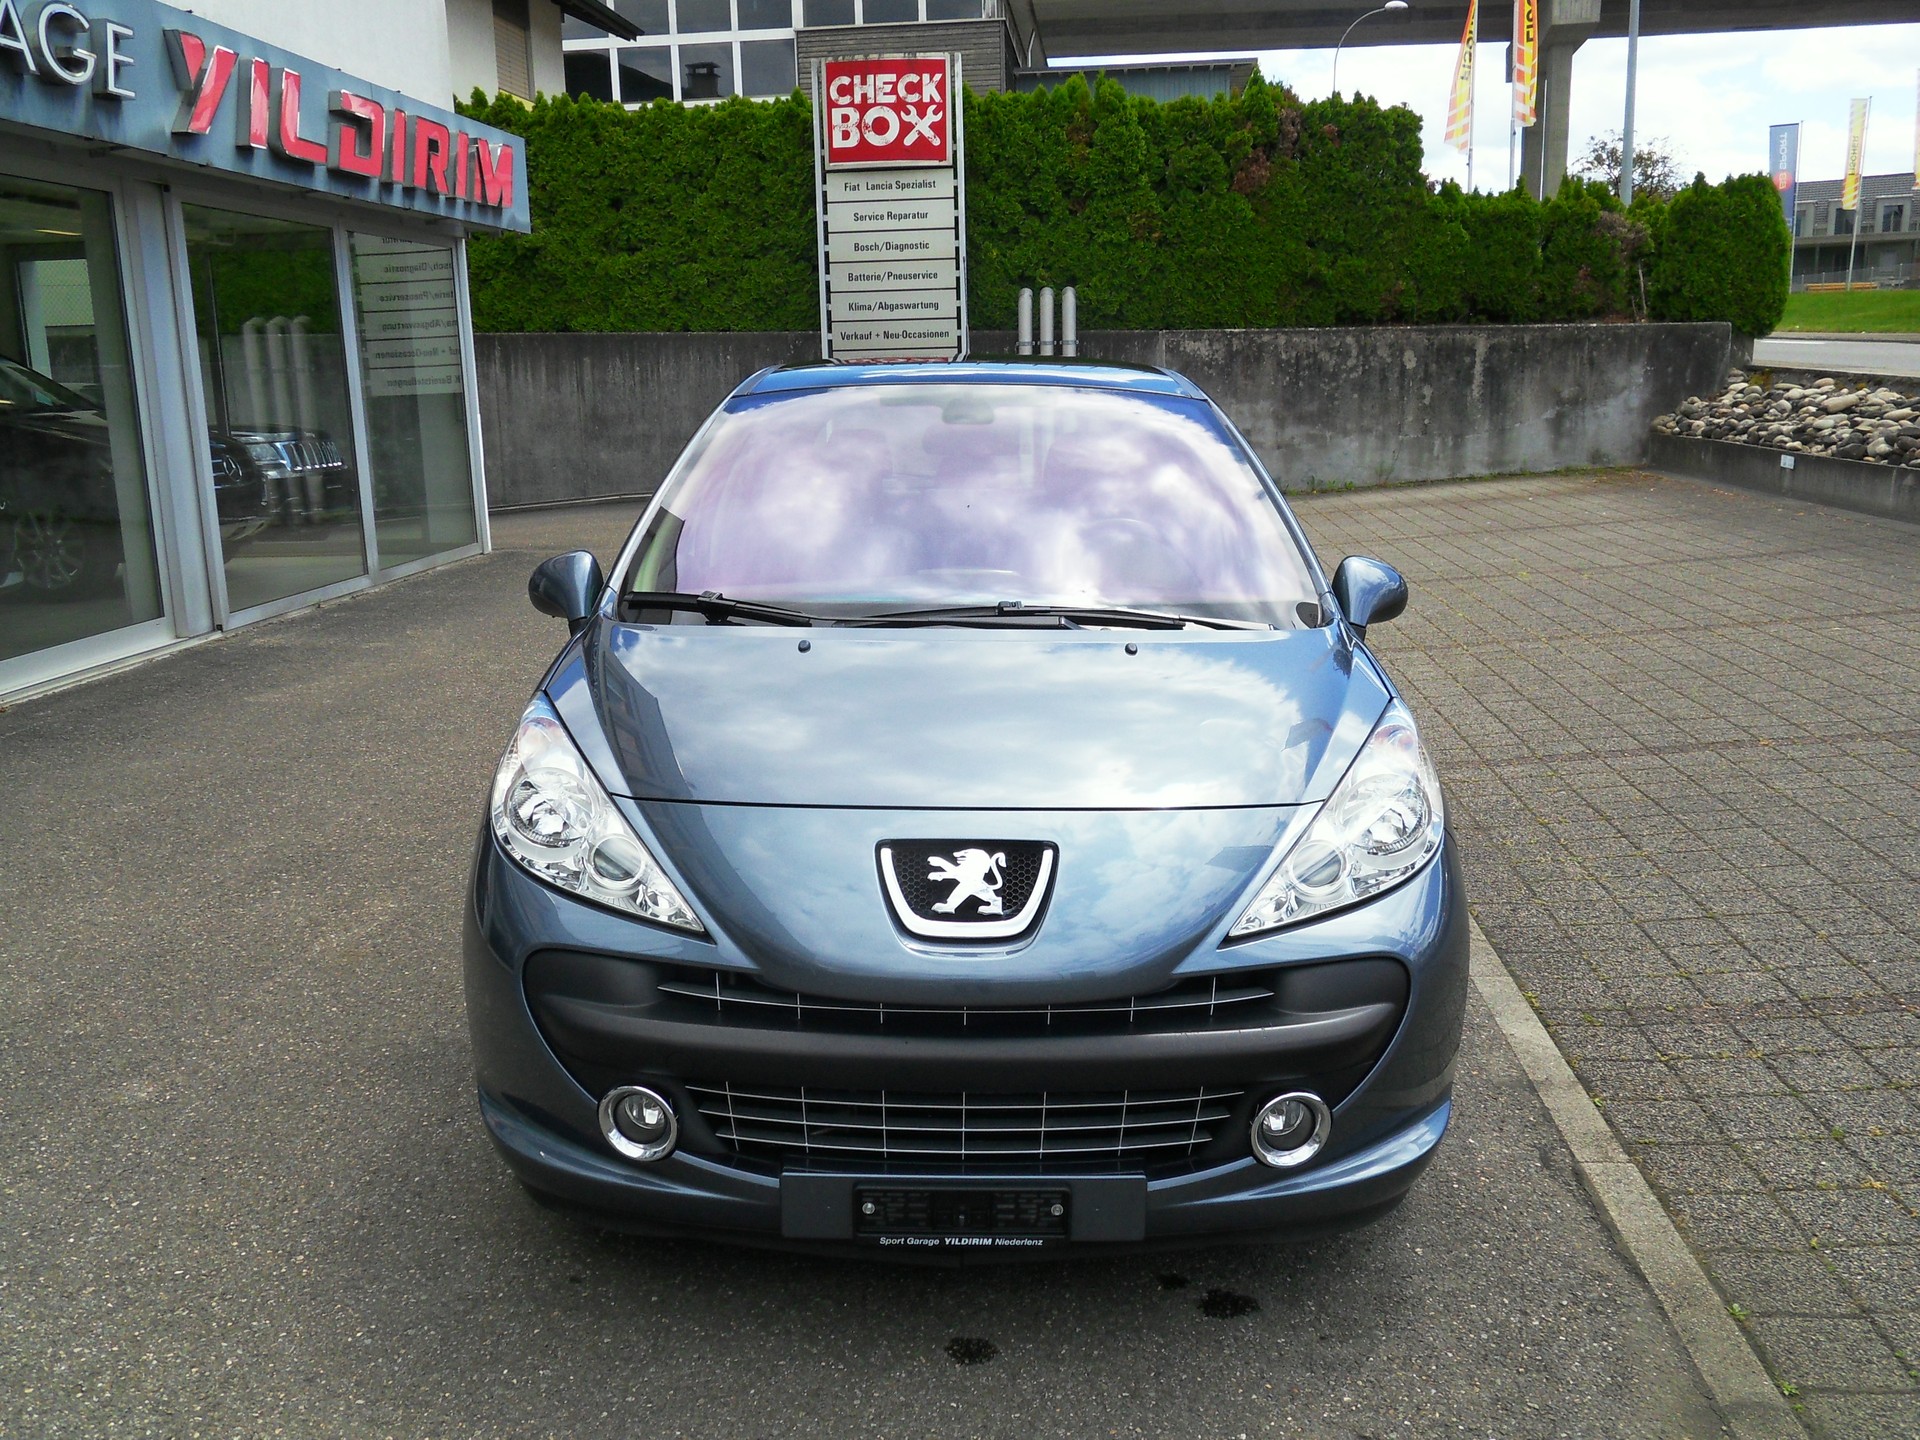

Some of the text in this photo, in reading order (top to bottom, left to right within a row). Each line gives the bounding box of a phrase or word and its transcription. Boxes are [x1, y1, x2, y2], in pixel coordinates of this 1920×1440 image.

[829, 73, 944, 105] CHECK
[164, 28, 514, 208] YILDIRIM
[831, 104, 943, 149] BOX
[844, 179, 936, 192] Fiat Lancia Spezialist
[853, 210, 929, 222] Service Reparatur
[853, 240, 930, 253] Bosch/Diagnostic
[847, 270, 938, 282] Batterie/Pneuservice
[848, 301, 939, 312] Klima/Abgaswartung
[840, 330, 872, 341] Verkauf
[883, 329, 949, 340] Neu-Occasionen
[879, 1236, 1043, 1247] Sport Garage YILDIRIM Niederlenz
